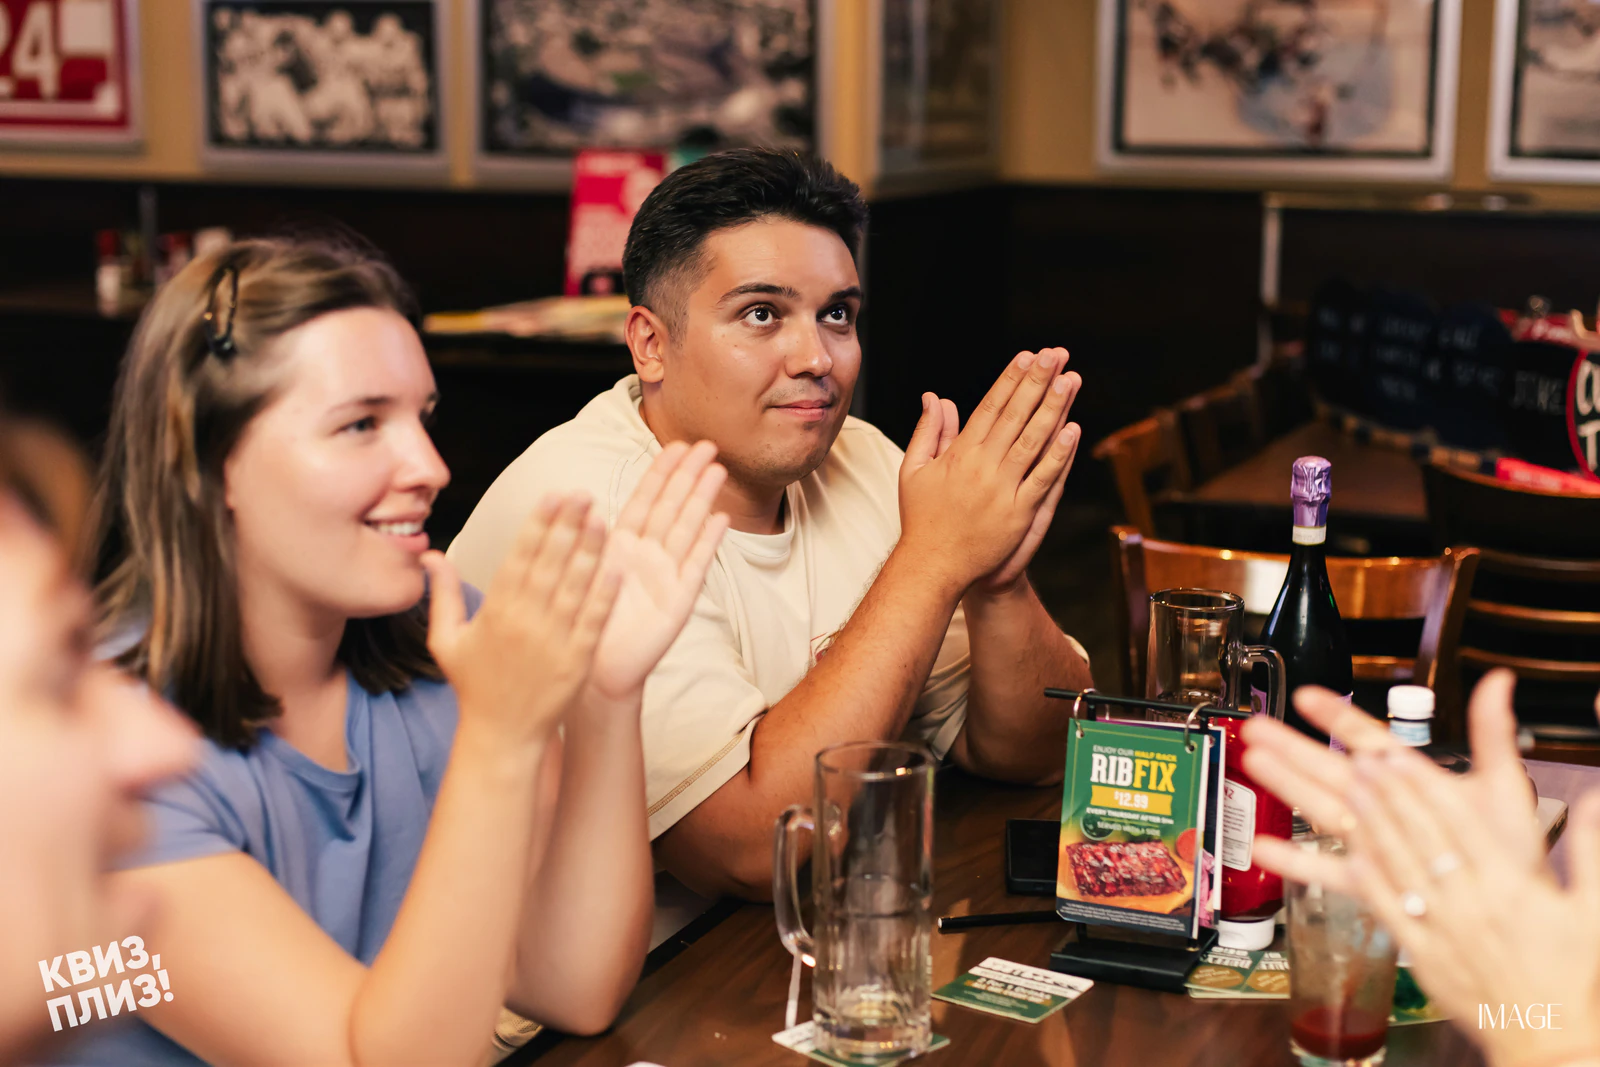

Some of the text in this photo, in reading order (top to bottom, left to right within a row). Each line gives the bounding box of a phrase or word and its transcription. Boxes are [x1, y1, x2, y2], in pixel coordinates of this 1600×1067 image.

[0, 0, 60, 98] 4
[1093, 745, 1117, 755] ENJOY
[1117, 748, 1134, 757] OUR
[1090, 753, 1177, 793] RIBFIX
[1114, 790, 1149, 809] $12.99
[1086, 807, 1107, 816] EVERY
[1107, 810, 1140, 820] THURSDAY
